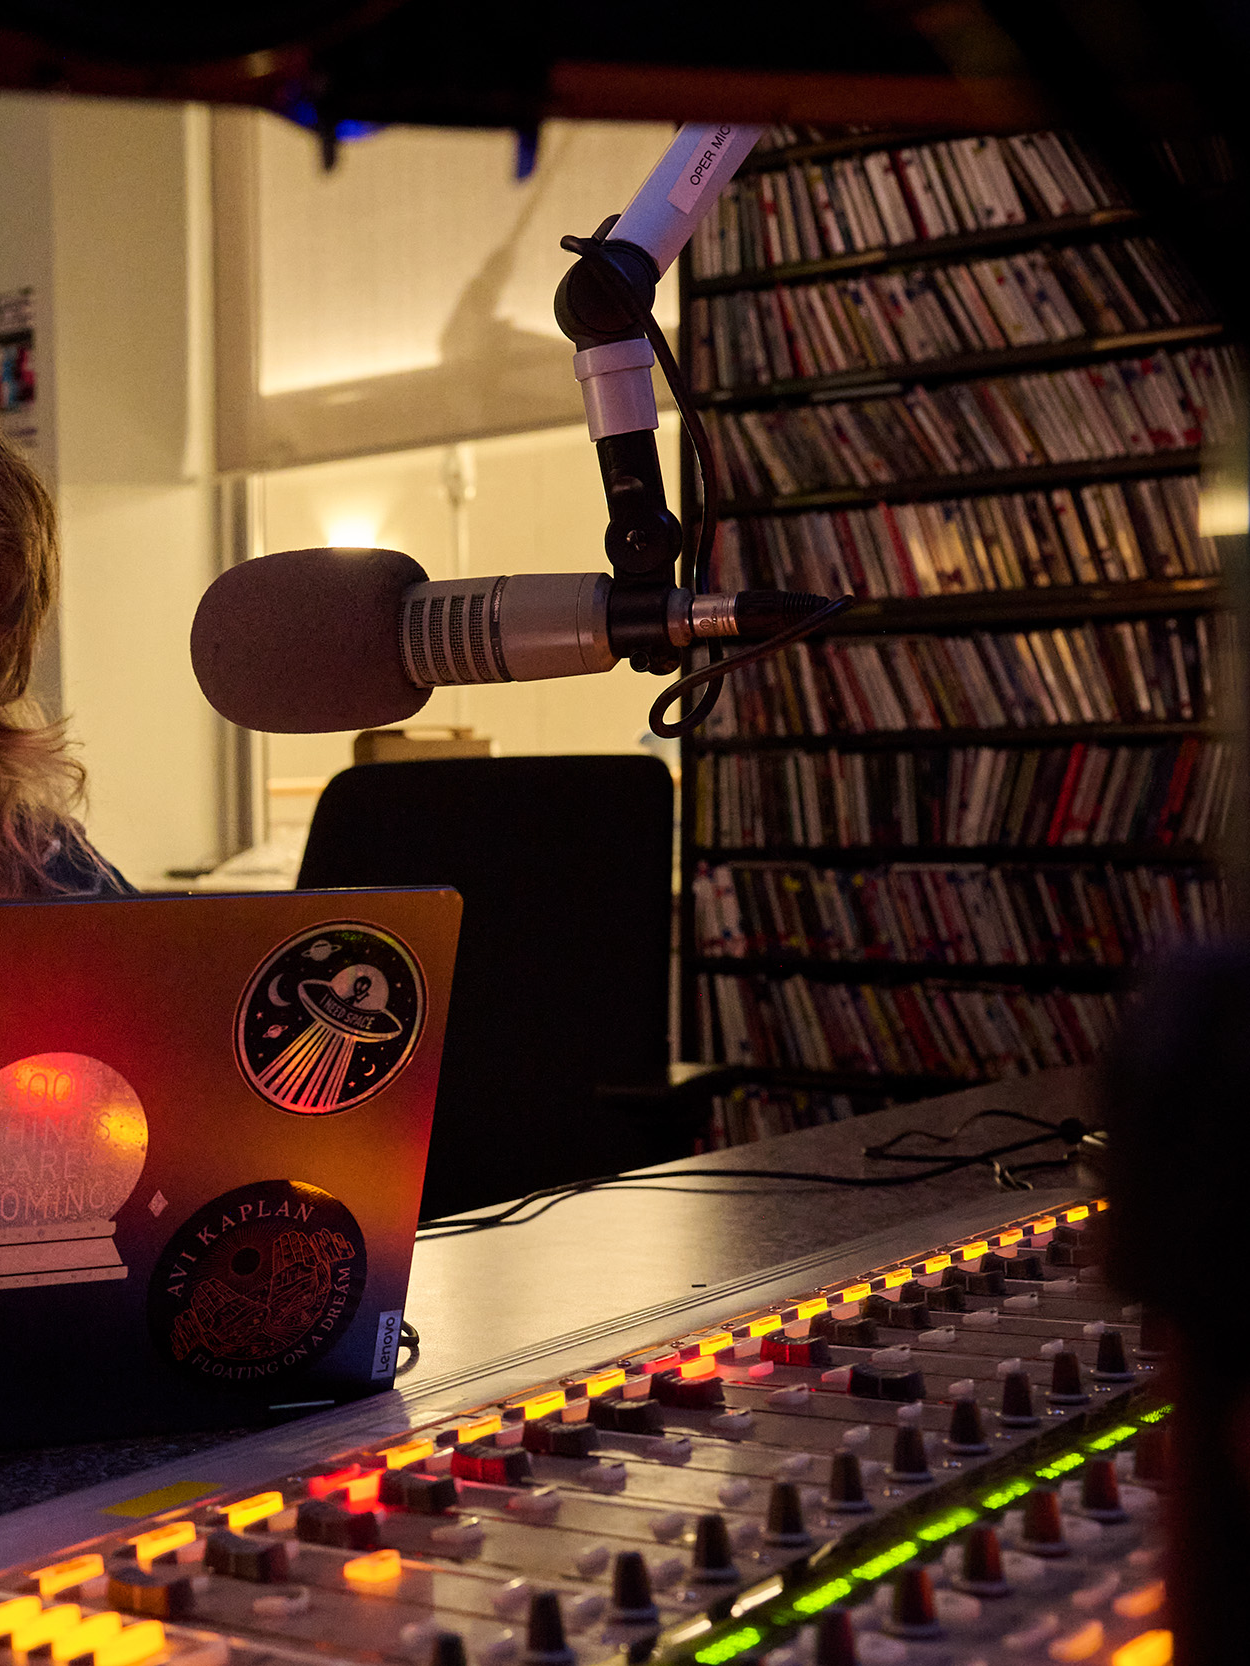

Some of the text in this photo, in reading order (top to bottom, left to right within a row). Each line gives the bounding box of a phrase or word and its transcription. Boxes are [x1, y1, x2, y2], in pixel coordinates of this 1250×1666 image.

[690, 124, 731, 186] OPER MIC
[319, 993, 376, 1030] I NEED SPACE
[9, 1147, 81, 1181] ARE
[166, 1199, 317, 1298] AVI KAPLAN
[190, 1352, 280, 1380] FLOATING
[283, 1344, 309, 1366] ON
[311, 1334, 324, 1348] A
[376, 1316, 396, 1373] Lenovo
